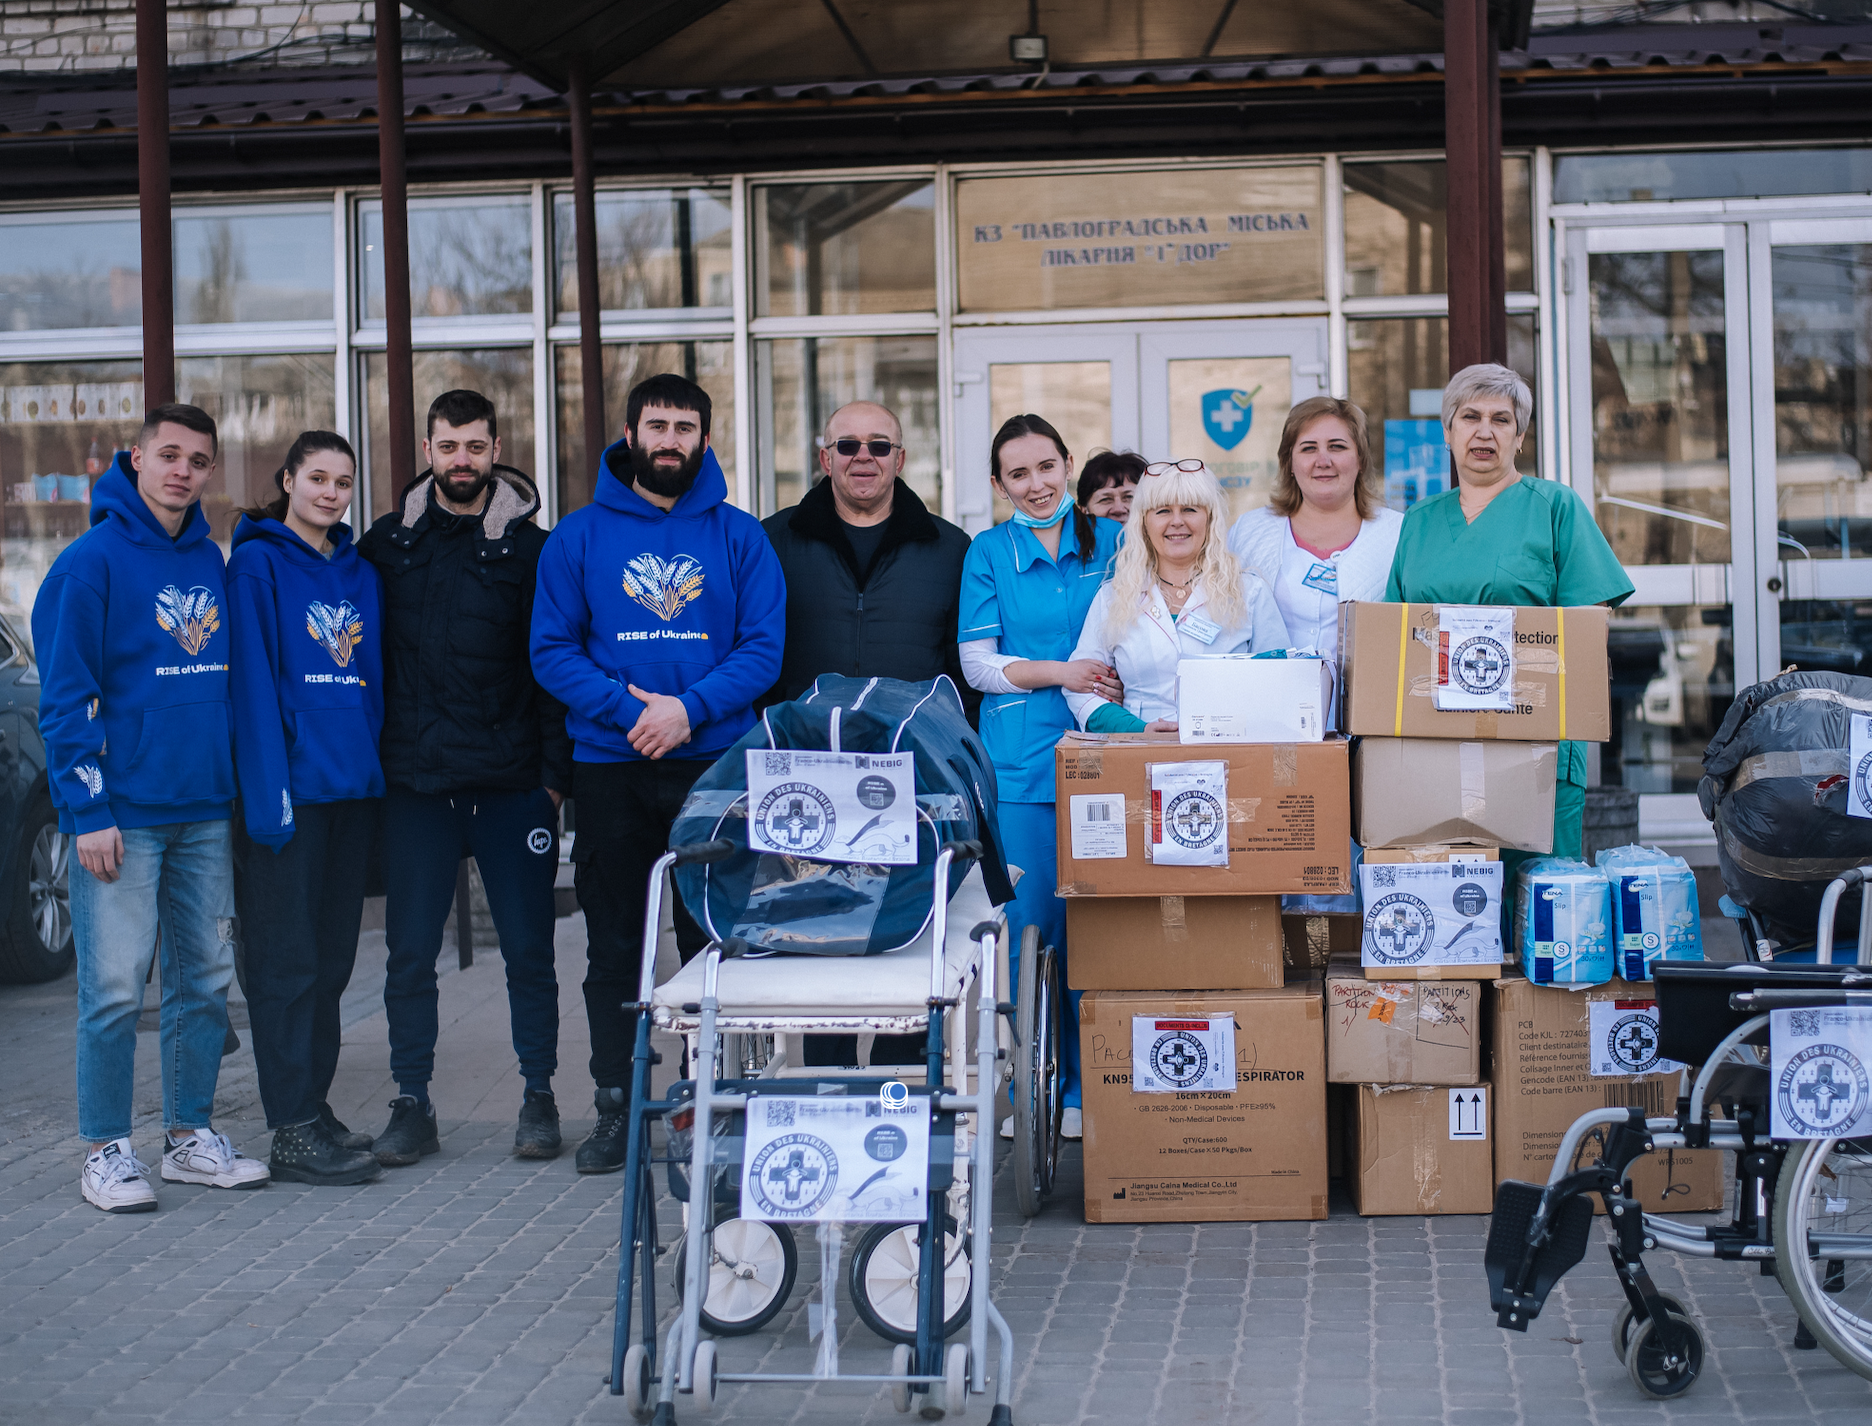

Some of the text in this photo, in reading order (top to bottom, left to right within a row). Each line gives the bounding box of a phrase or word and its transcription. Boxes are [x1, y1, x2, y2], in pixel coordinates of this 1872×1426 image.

[974, 224, 1002, 242] КЗ
[1227, 213, 1309, 232] МІСЬКА
[1041, 245, 1136, 267] ЛІКАРНЯ
[617, 630, 648, 641] RISE
[649, 630, 660, 640] of
[1515, 630, 1559, 645] tection
[155, 666, 180, 676] RISE
[181, 665, 191, 674] of
[304, 674, 333, 683] RISE
[871, 759, 903, 768] NEBIG
[1065, 771, 1077, 779] LEC
[757, 783, 836, 821] UNION DES UKRAINIENS
[1303, 866, 1340, 875] LEC 028801
[1466, 867, 1494, 875] NEBIG
[1366, 893, 1435, 928] UNION DES UKRAINIENS
[1647, 936, 1654, 944] S
[1558, 945, 1565, 953] S
[1374, 950, 1385, 961] EN
[1518, 1021, 1534, 1029] PCB
[1180, 1032, 1199, 1047] UNION
[1519, 1032, 1539, 1040] Code
[1540, 1031, 1553, 1039] KJL
[1519, 1041, 1588, 1051] Client destinataire
[1520, 1053, 1558, 1062] Référence
[1520, 1065, 1552, 1074] Colisage
[1554, 1064, 1573, 1072] Inner
[1780, 1045, 1868, 1088] UNION DES UKRAINIENS
[1237, 1070, 1304, 1082] ESPIRATOR
[1521, 1076, 1555, 1084] Gencode
[1557, 1075, 1575, 1084] (EAN
[1543, 1087, 1563, 1095] barre
[1565, 1085, 1583, 1094] (EAN
[1586, 1084, 1597, 1092] 13)
[1194, 1104, 1234, 1113] Disposable
[1169, 1115, 1215, 1123] Non-Medical
[1790, 1118, 1803, 1132] EN
[752, 1134, 839, 1173] UNION DES UKRAINIENS
[1221, 1146, 1252, 1154] Pkgs/Box
[760, 1199, 772, 1214] EN
